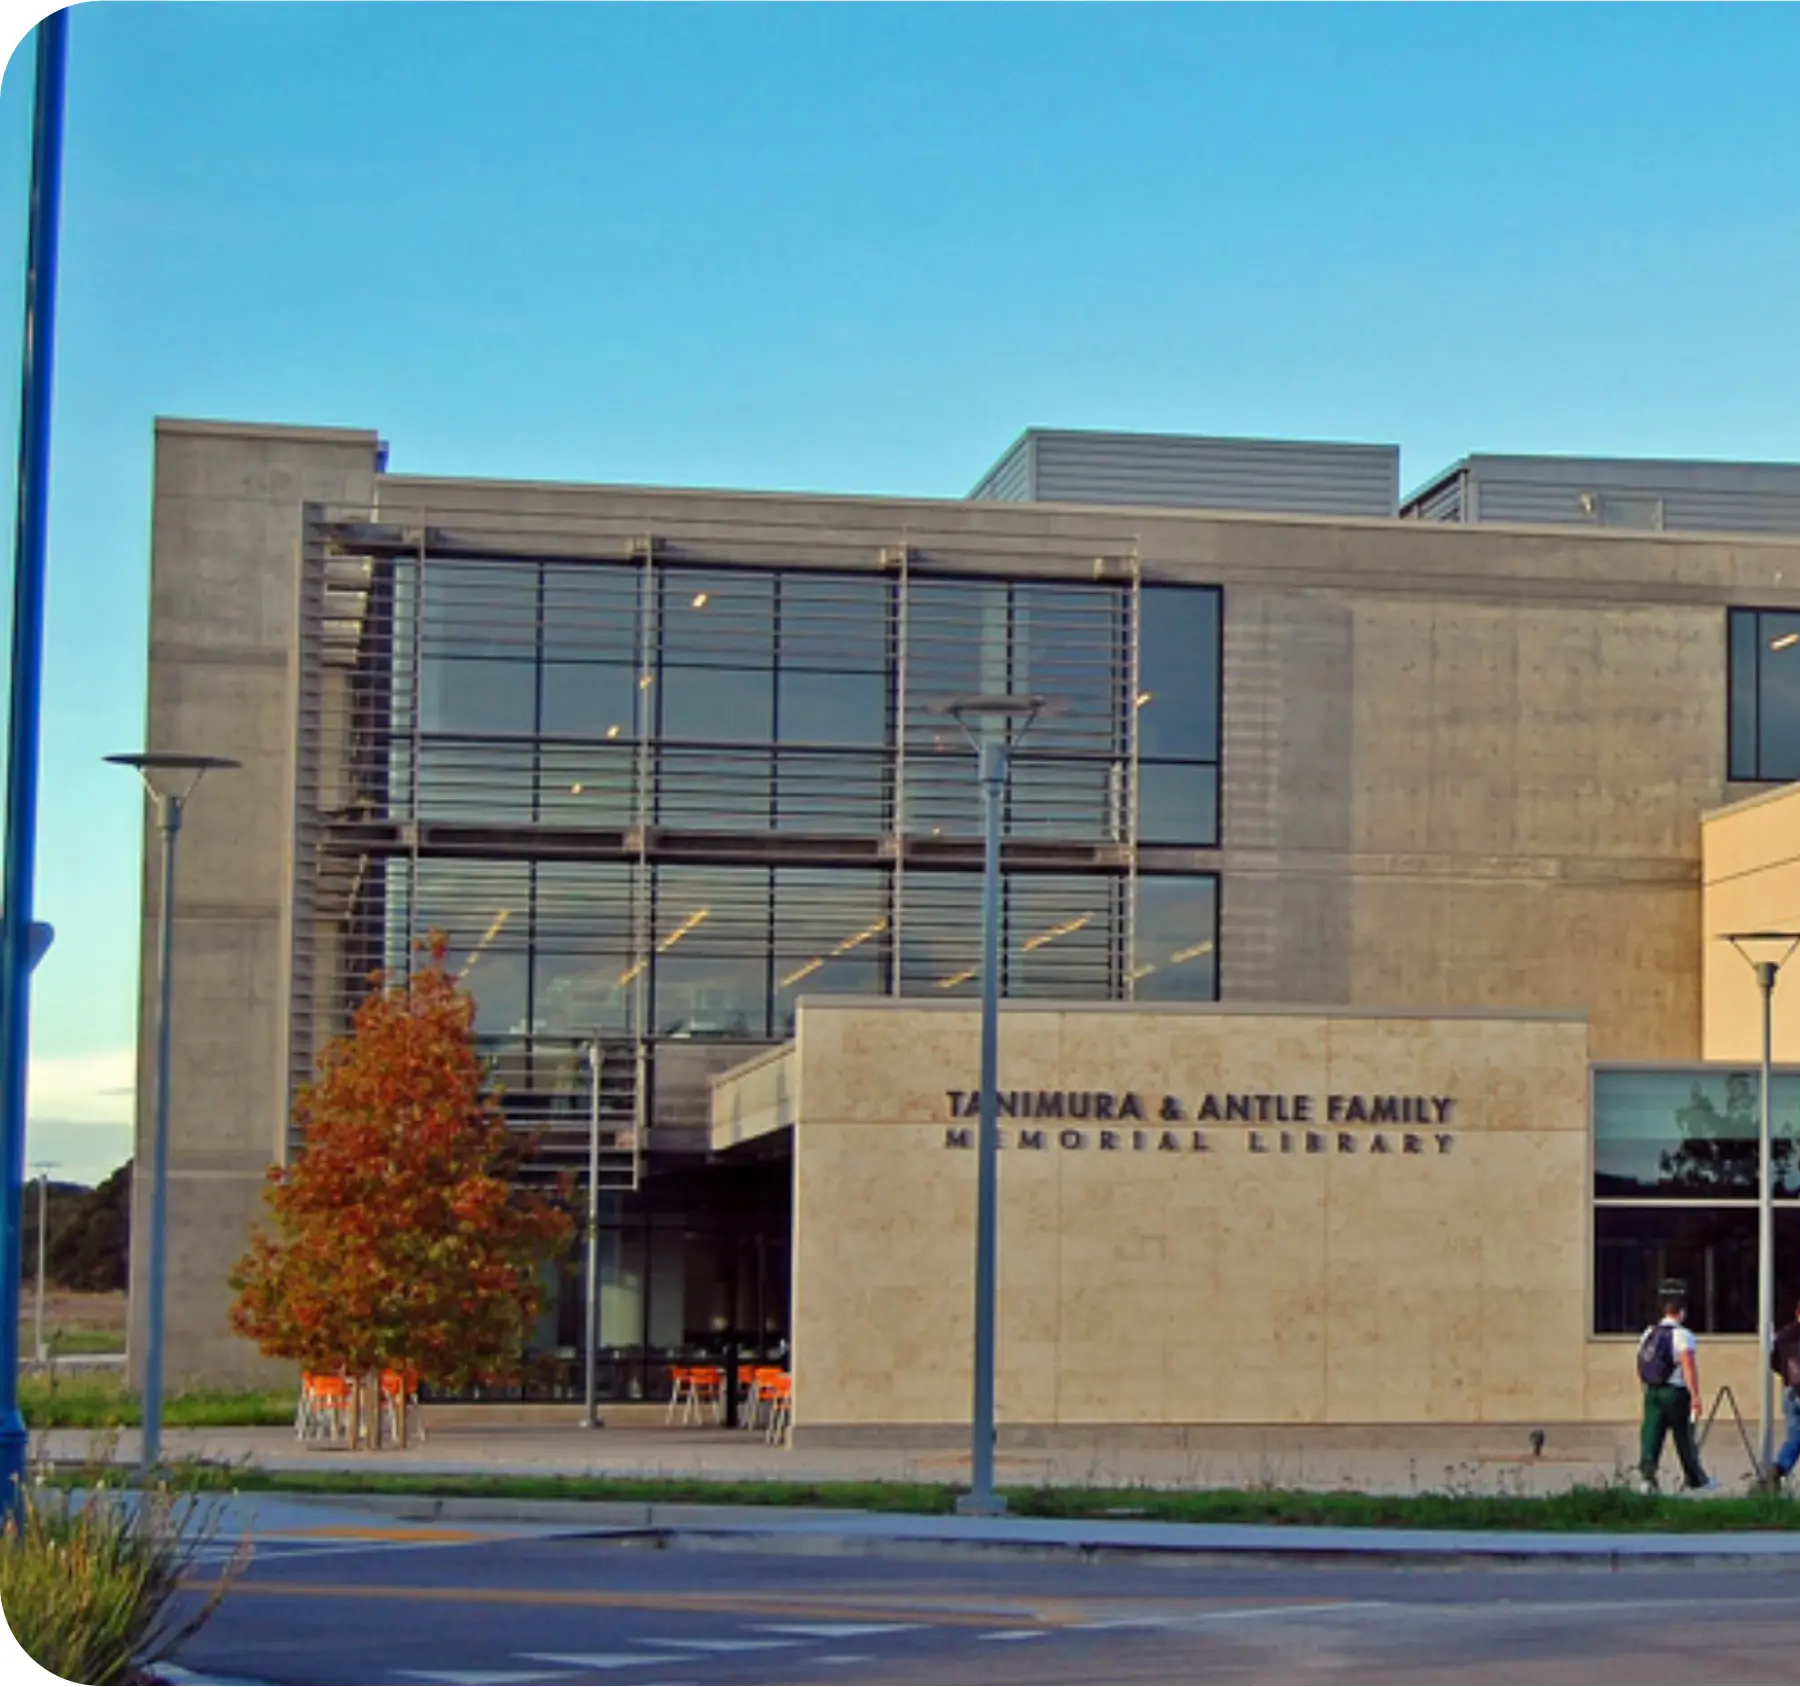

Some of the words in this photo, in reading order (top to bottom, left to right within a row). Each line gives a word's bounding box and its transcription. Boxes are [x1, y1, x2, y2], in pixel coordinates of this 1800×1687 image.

[945, 1090, 1145, 1119] TANIMURA
[1159, 1094, 1186, 1121] &
[1197, 1093, 1313, 1122] ANTLE
[1327, 1095, 1453, 1124] FAMILY
[1249, 1131, 1453, 1153] LIBRARY
